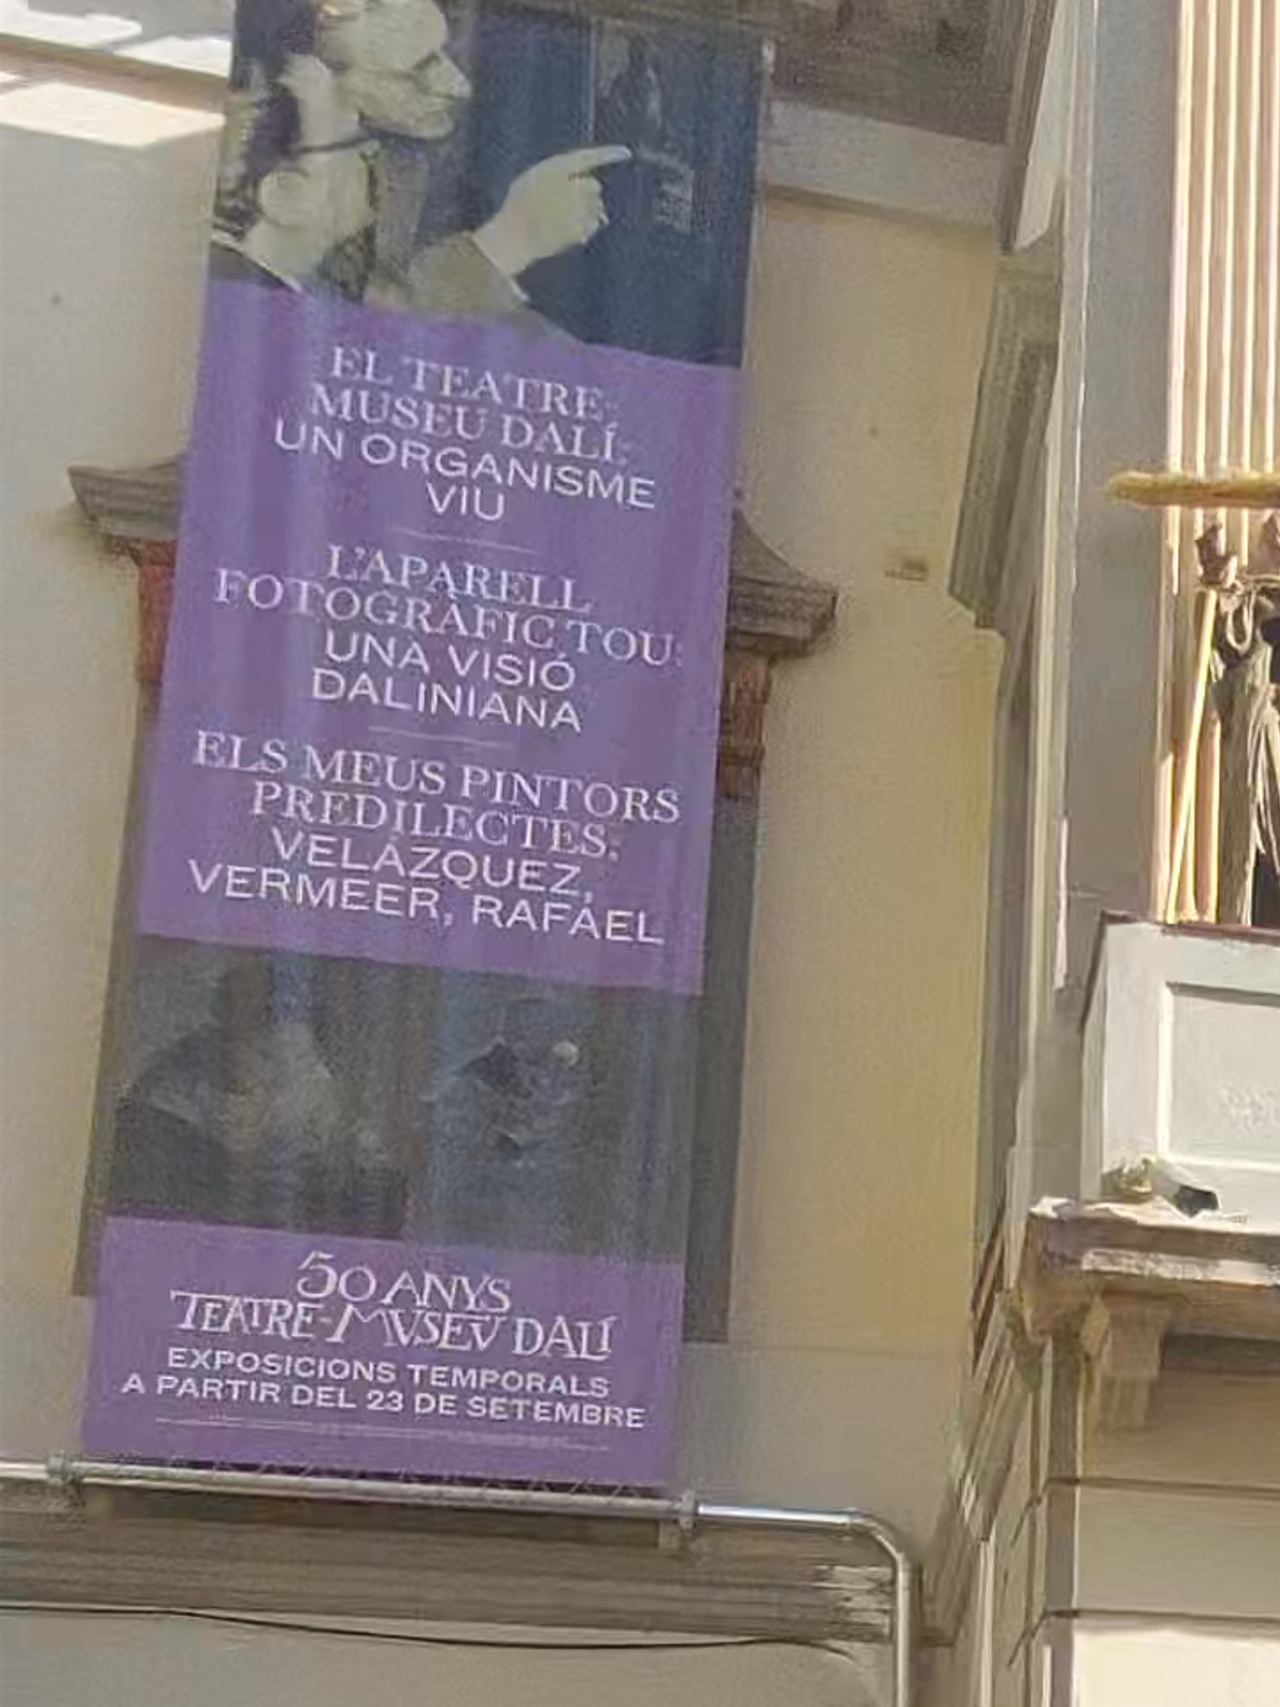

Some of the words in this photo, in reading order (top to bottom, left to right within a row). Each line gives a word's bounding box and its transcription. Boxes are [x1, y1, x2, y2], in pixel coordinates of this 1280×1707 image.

[331, 346, 393, 385] EL
[311, 383, 488, 440] MUSEU
[275, 417, 344, 460] UN
[361, 433, 656, 509] ORGANISME
[426, 483, 505, 521] VIU
[325, 630, 430, 675] UNA
[448, 643, 577, 693] VISIÓ
[312, 668, 582, 732] DALINIANA
[192, 731, 288, 774] ELS
[303, 745, 446, 796] MEUS
[462, 765, 680, 823] PINTORS
[272, 827, 595, 902] VELÁZQUEZ,
[188, 860, 455, 926] VERMEER,
[473, 894, 665, 945] RAFAEL
[298, 1250, 375, 1302] 50
[382, 1269, 512, 1315] ANYS
[513, 1316, 619, 1361] DALÍ
[122, 1374, 145, 1393] A
[156, 1376, 283, 1406] PARTIR
[292, 1384, 356, 1410] DEL
[366, 1390, 404, 1413] 23
[414, 1394, 457, 1417] DE
[467, 1396, 646, 1429] SETEMBRE
[167, 1347, 397, 1384] EXPOSICIONS
[407, 1364, 611, 1398] TEMPORALS
